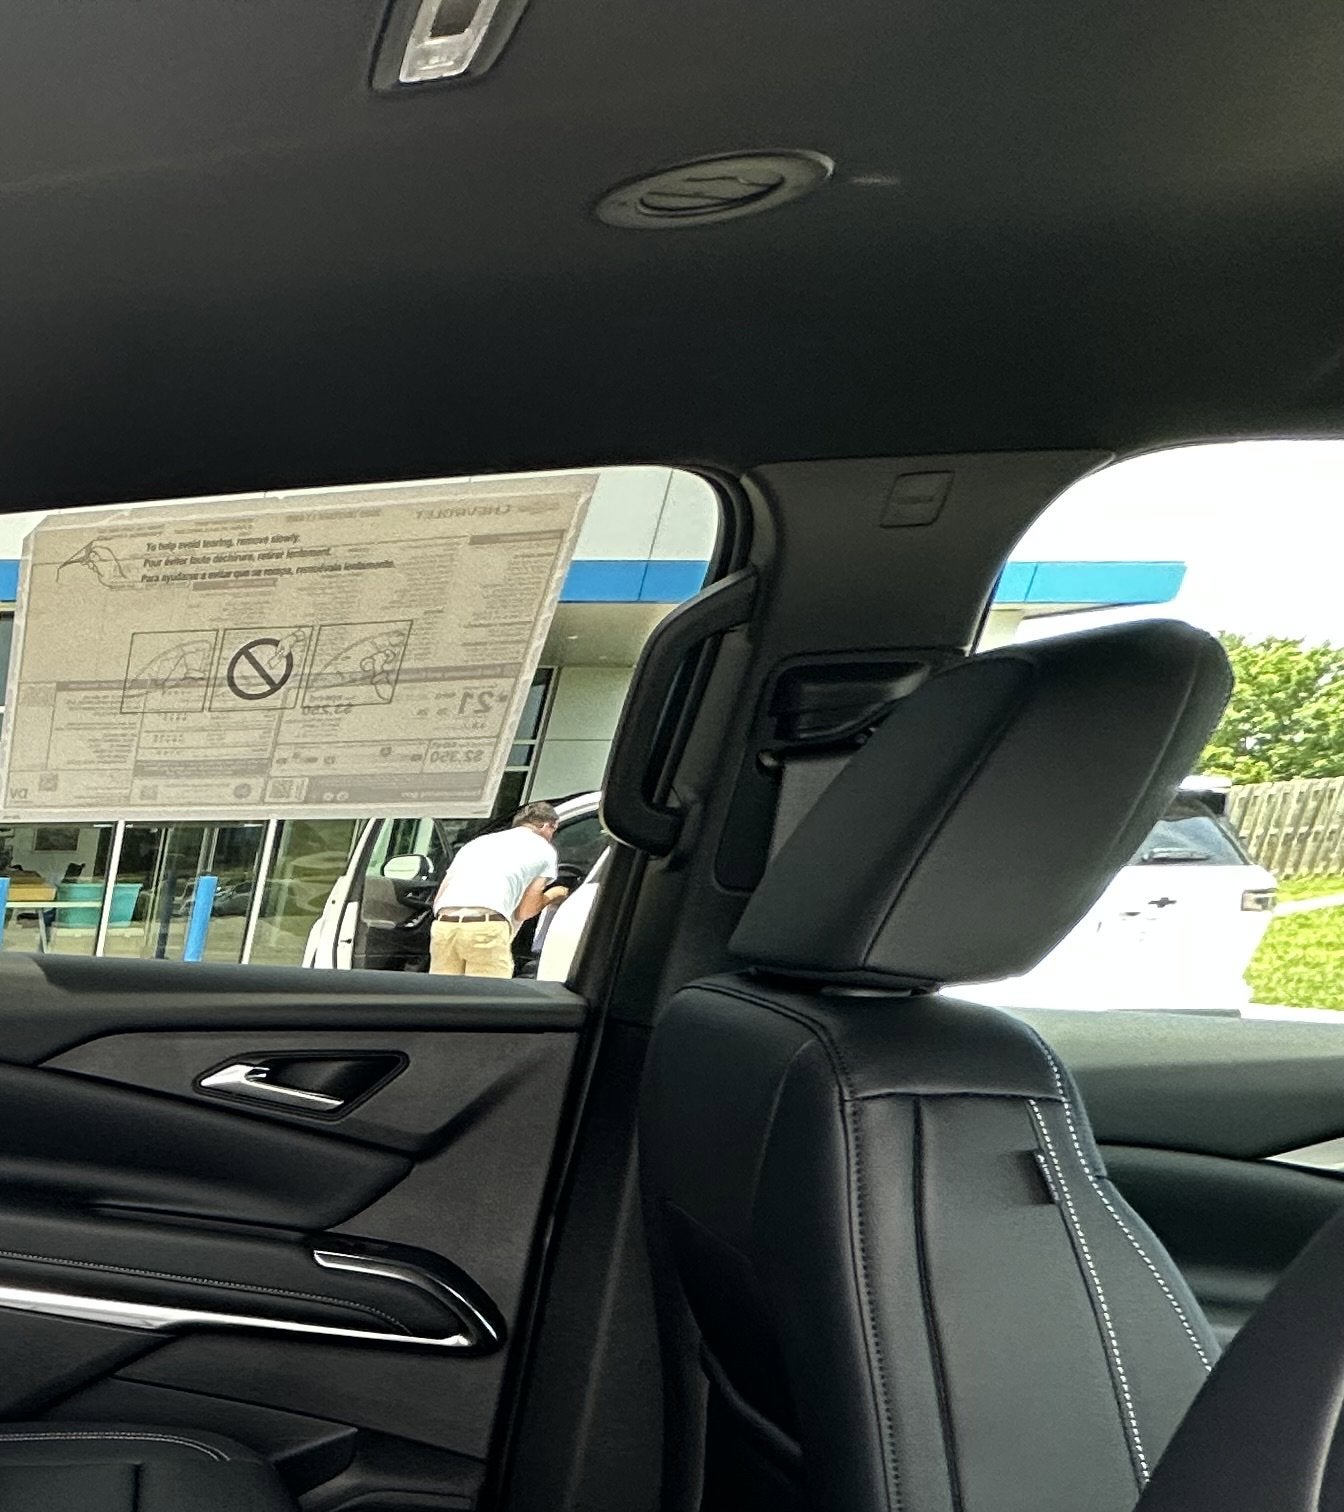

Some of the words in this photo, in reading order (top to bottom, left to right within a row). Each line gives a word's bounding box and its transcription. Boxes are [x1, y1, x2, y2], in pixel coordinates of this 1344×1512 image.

[146, 542, 157, 552] To
[158, 541, 177, 553] help
[143, 558, 163, 568] Pour
[141, 573, 160, 583] Para
